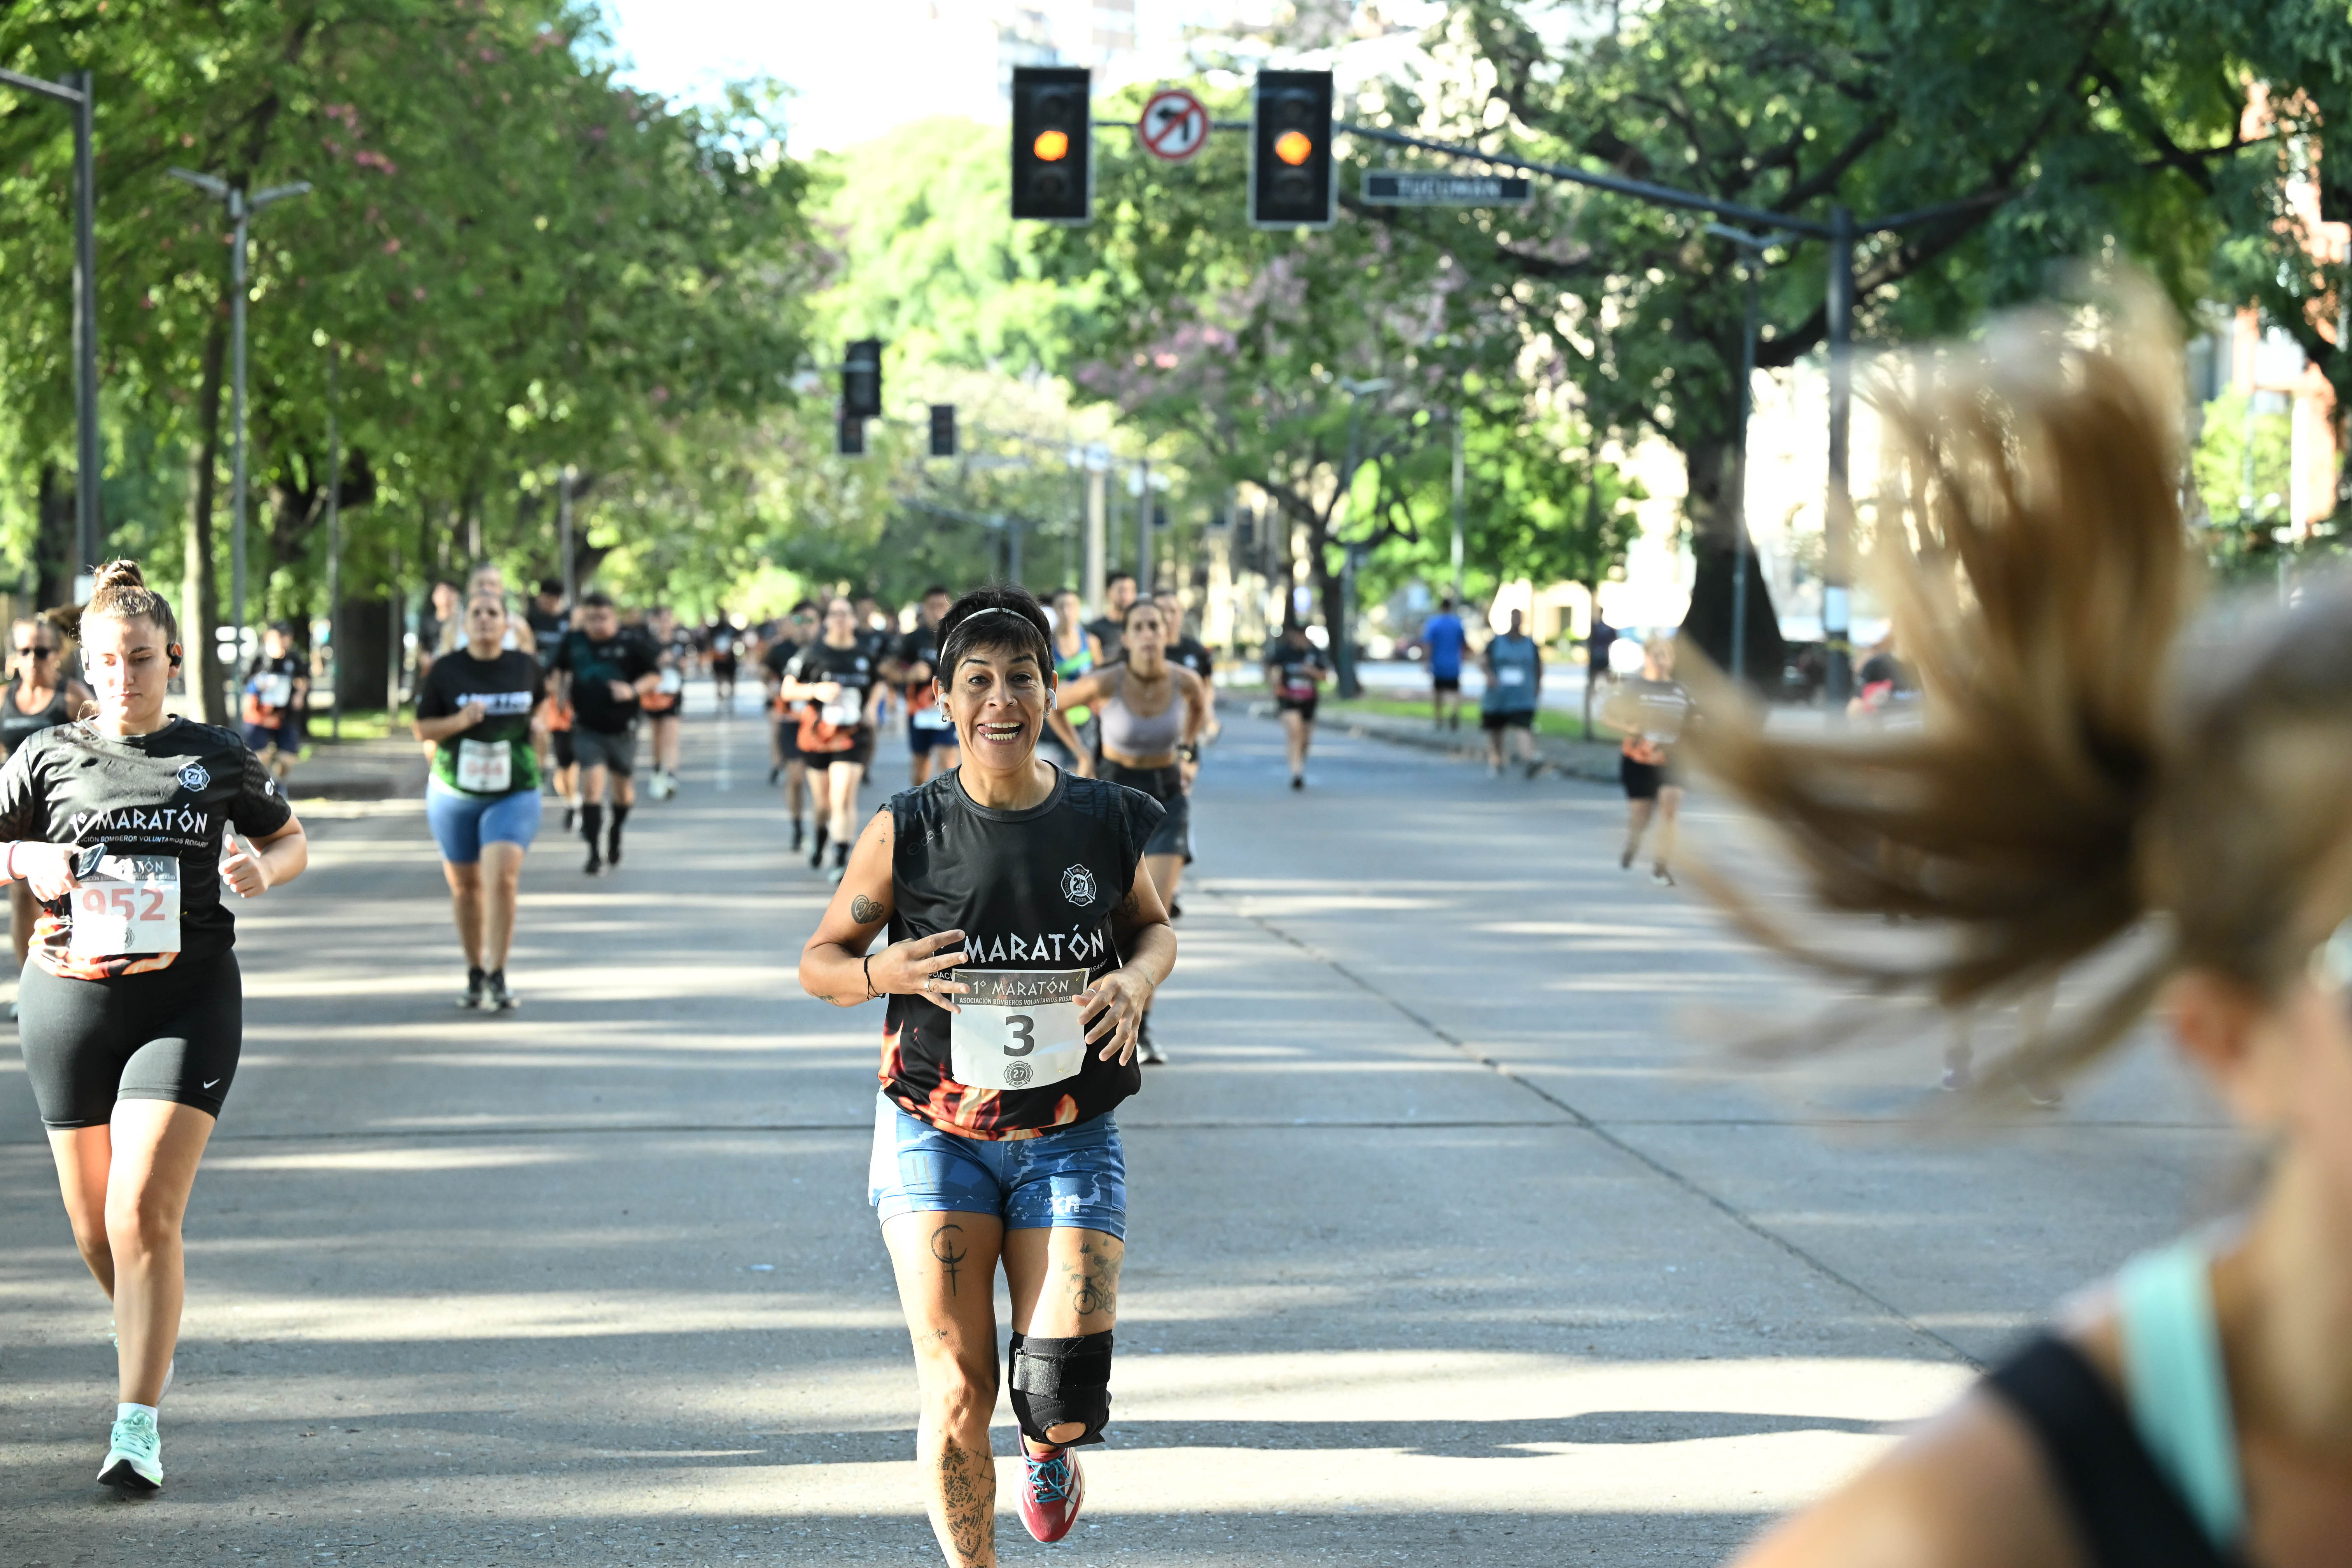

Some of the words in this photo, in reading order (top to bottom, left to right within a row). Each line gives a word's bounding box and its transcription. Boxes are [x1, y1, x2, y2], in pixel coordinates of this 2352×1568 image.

[188, 771, 200, 780] 27
[96, 803, 208, 834] MARATÓN
[1073, 877, 1086, 891] 27
[82, 888, 165, 921] 952
[963, 924, 1104, 963] MARATÓN
[992, 976, 1069, 996] MARATÓN
[1024, 997, 1057, 1006] VOLUNTARIOS
[1004, 1015, 1034, 1057] 3
[1013, 1069, 1024, 1078] 27
